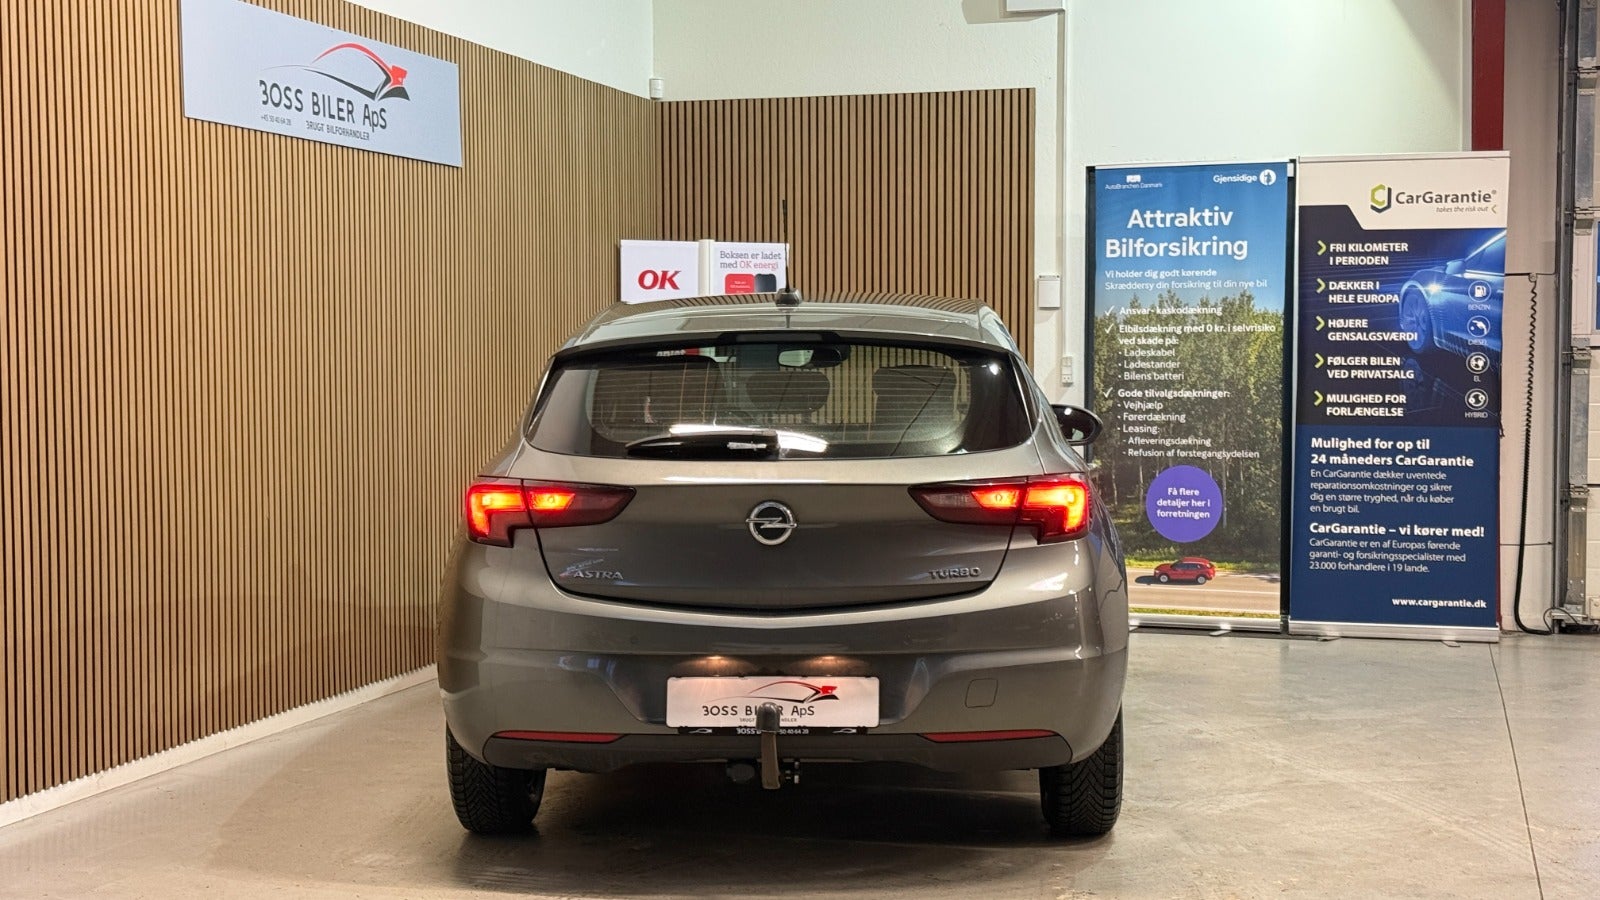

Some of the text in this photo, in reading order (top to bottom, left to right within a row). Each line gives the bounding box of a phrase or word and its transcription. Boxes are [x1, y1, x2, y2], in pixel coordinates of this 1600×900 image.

[312, 92, 355, 123] BILER
[363, 103, 387, 132] ApS
[326, 124, 369, 140] BILFORHANDLER
[1213, 174, 1257, 183] Gjensidige
[1127, 206, 1233, 228] Attraktiv
[1105, 236, 1247, 260] Bilforsikring
[1330, 243, 1408, 252] FRI KILOMETER
[720, 251, 749, 259] Boksen
[740, 260, 752, 268] OK
[753, 262, 778, 271] energi
[1330, 256, 1389, 265] I PERIODEN
[1145, 270, 1158, 279] dig
[1160, 270, 1180, 279] godt
[1182, 269, 1217, 277] kørende
[638, 269, 681, 290] OK
[1105, 282, 1154, 291] Skræddersy
[1171, 281, 1211, 290] forsikring
[1239, 281, 1255, 289] nye
[1329, 281, 1379, 290] DÆKKER I
[1329, 294, 1399, 303] HELE EUROPA
[1157, 306, 1222, 315] kaskodækning
[1328, 319, 1368, 328] HØJERE
[1119, 324, 1182, 334] Elbilsdækning
[1207, 324, 1212, 332] 0
[1214, 324, 1226, 332] kr.
[1233, 324, 1276, 332] selvrisiko
[1119, 337, 1135, 345] ved
[1165, 337, 1179, 346] på:
[1328, 332, 1418, 341] GENSALGSVÆRDI
[1124, 349, 1175, 357] Ladeskabel
[1327, 356, 1400, 366] FØLGER BILEN
[1124, 372, 1184, 380] Bilens batteri
[1327, 370, 1414, 379] VED PRIVATSALG
[1118, 389, 1231, 399] Gode tilvalgsdækninger:
[1327, 394, 1406, 404] MULIGHED FOR
[1123, 401, 1163, 410] Vejhjælp
[1327, 407, 1403, 416] FORLÆNGELSE
[1123, 413, 1186, 423] Førerdækning
[1123, 425, 1160, 434] Leasing:
[1128, 437, 1211, 447] Afleveringsdækning
[1311, 438, 1430, 452] Mulighed for op til
[1128, 449, 1164, 457] Refusion
[1311, 453, 1474, 466] 24 måneders CarGarantie
[1310, 469, 1446, 479] En CarGarantie dækker uventede
[1168, 487, 1177, 495] Få
[1310, 482, 1414, 492] reparationsomkostninger
[1430, 483, 1452, 491] sikrer
[1157, 498, 1190, 508] detaljer
[1192, 499, 1206, 507] her
[1310, 493, 1324, 502] dig
[1401, 494, 1414, 502] når
[1416, 494, 1428, 502] du
[1430, 495, 1454, 503] køber
[1157, 509, 1210, 519] forretningen
[1323, 504, 1345, 514] brugt
[1348, 505, 1360, 513] bil.
[1310, 523, 1386, 534] CarGarantie
[1399, 525, 1411, 535] vi
[1414, 525, 1448, 536] kører
[1452, 527, 1485, 537] med!
[1309, 538, 1358, 547] CarGarantie
[1382, 540, 1390, 548] af
[1392, 540, 1425, 550] Europas
[1428, 541, 1460, 550] førende
[1309, 551, 1466, 562] garanti- og forsikringsspecialister med
[1309, 561, 1336, 569] 23.000
[1338, 562, 1385, 571] forhandlere
[1405, 564, 1430, 572] lande.
[574, 571, 623, 580] ASTRA
[929, 567, 981, 579] TURBO
[1392, 598, 1487, 608] www.cargarantie.dk
[791, 705, 814, 717] ApS
